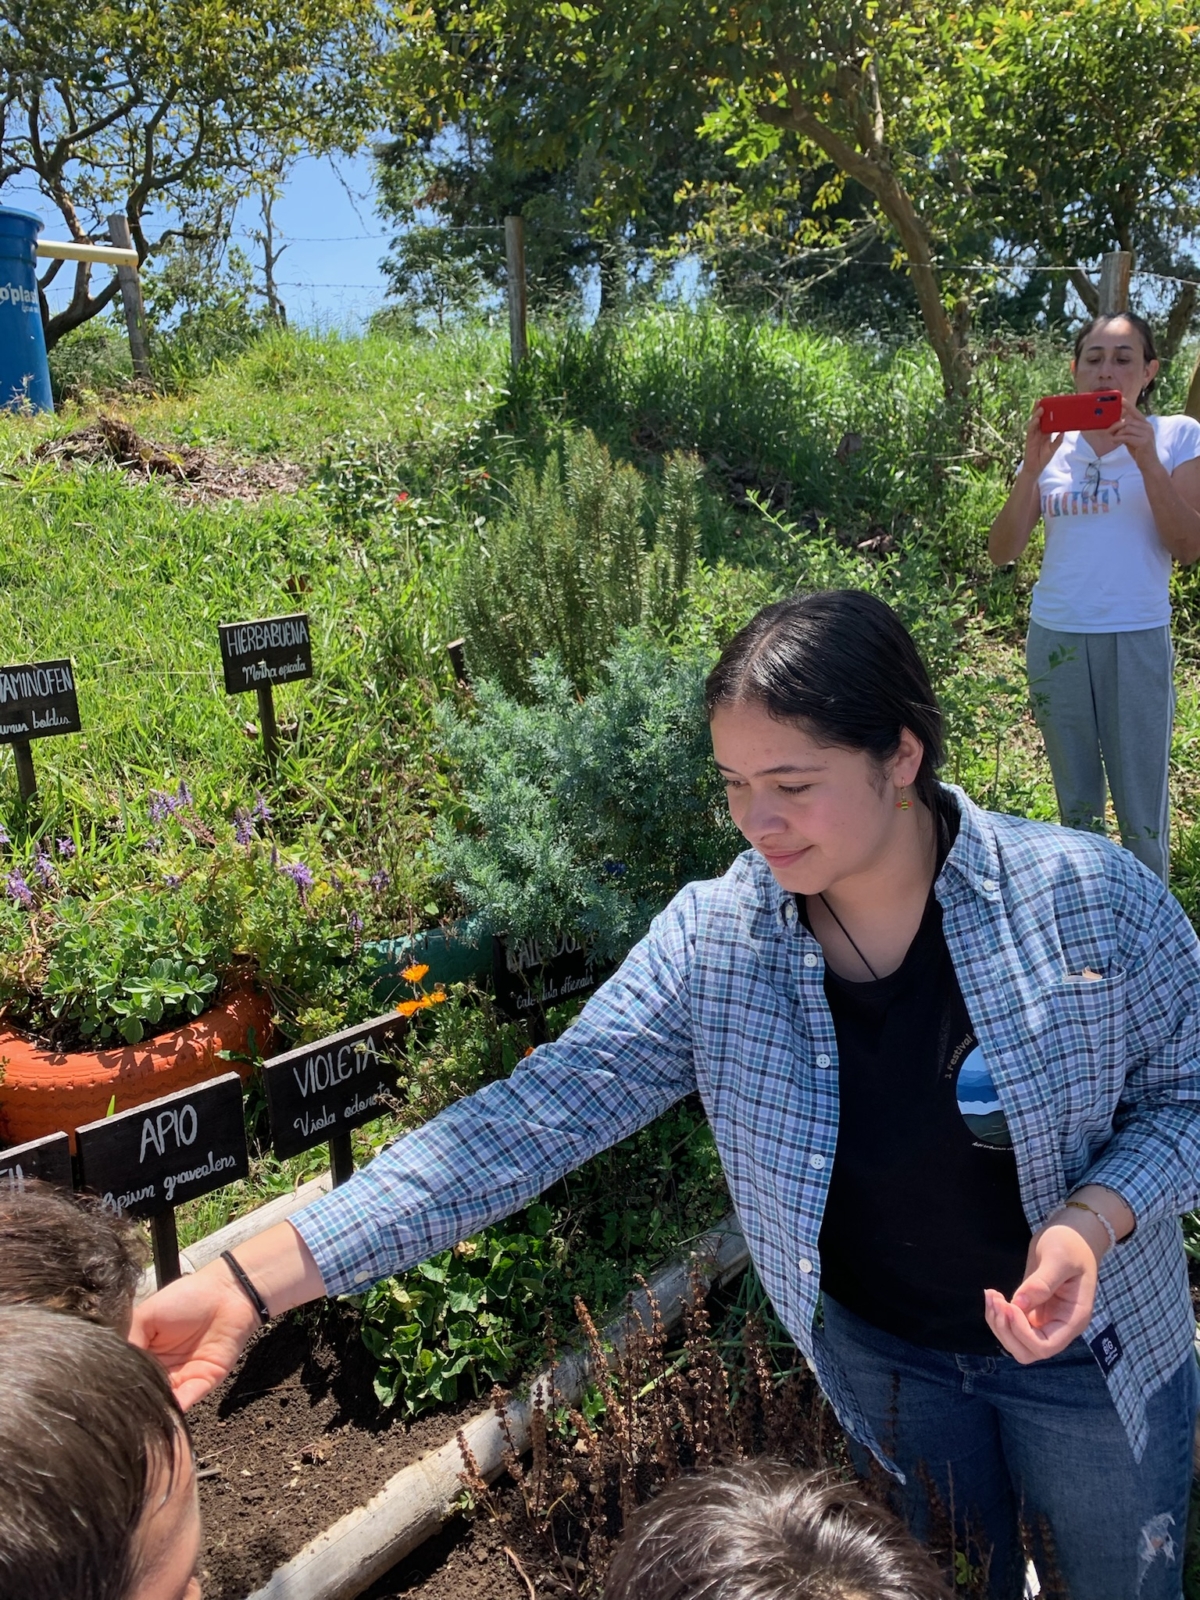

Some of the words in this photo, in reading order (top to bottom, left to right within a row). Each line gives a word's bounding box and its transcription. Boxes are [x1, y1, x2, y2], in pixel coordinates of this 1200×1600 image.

[226, 621, 309, 657] HIERBABUENA
[32, 707, 72, 729] boldus
[293, 1034, 379, 1098] VIOLETA
[946, 1033, 974, 1071] Festival
[139, 1104, 198, 1164] APIO
[293, 1105, 337, 1138] Viola
